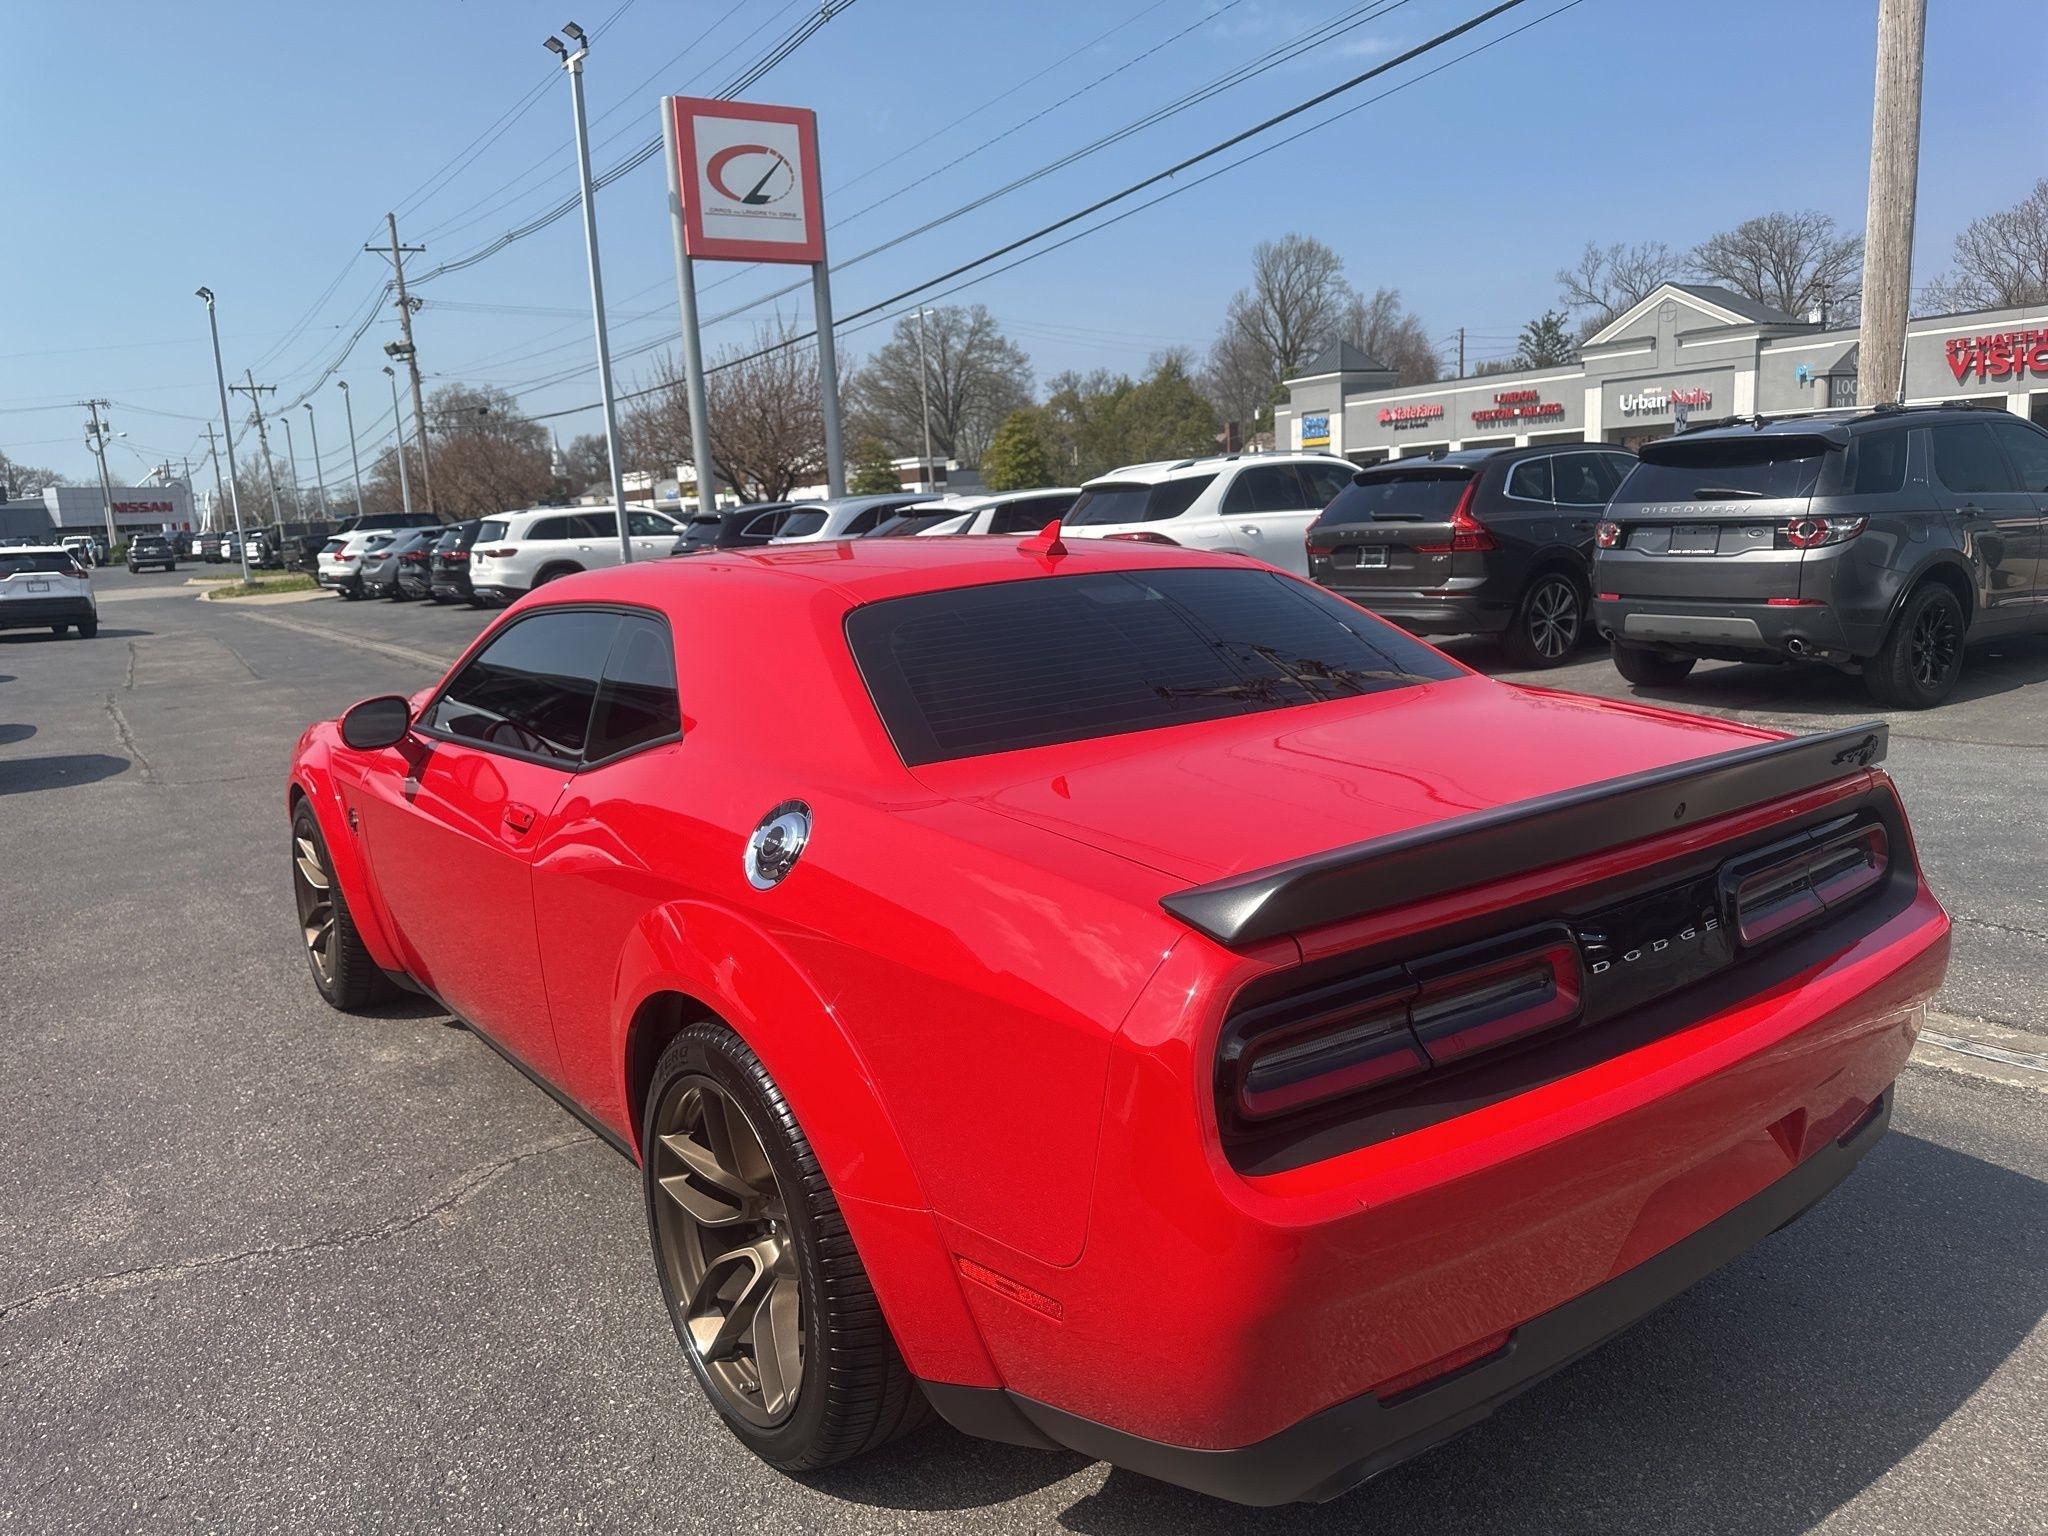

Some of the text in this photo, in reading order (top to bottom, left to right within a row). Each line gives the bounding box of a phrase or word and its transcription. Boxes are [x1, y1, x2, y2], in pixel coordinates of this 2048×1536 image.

[1494, 389, 1538, 404] LONDON
[1619, 387, 1712, 411] Urban Nails
[1471, 407, 1514, 421] CUSTOM
[112, 502, 174, 512] NISSAN
[1641, 504, 1752, 514] DISCOVERY
[1592, 918, 1719, 974] DODGE
